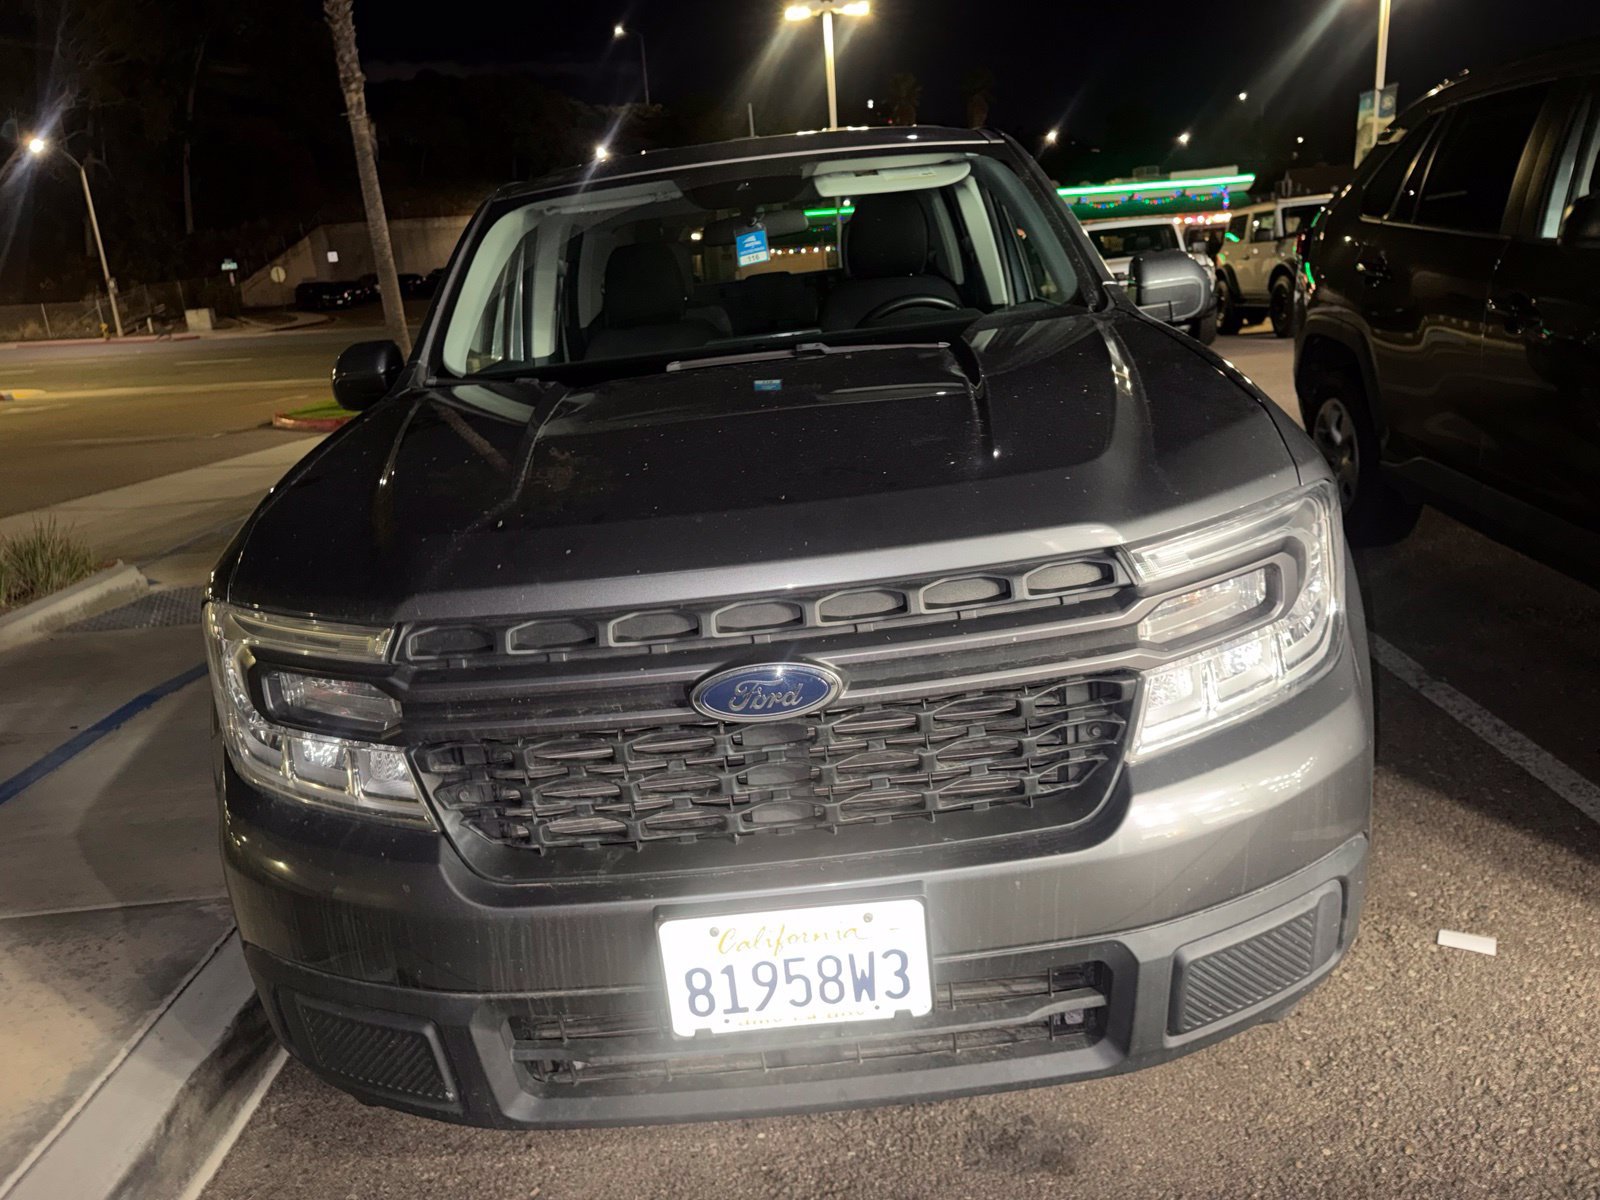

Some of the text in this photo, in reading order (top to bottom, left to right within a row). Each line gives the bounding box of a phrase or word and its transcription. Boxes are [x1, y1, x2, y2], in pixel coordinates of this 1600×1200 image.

[728, 678, 803, 712] Ford
[717, 923, 870, 957] California
[684, 948, 911, 1018] 81958W3
